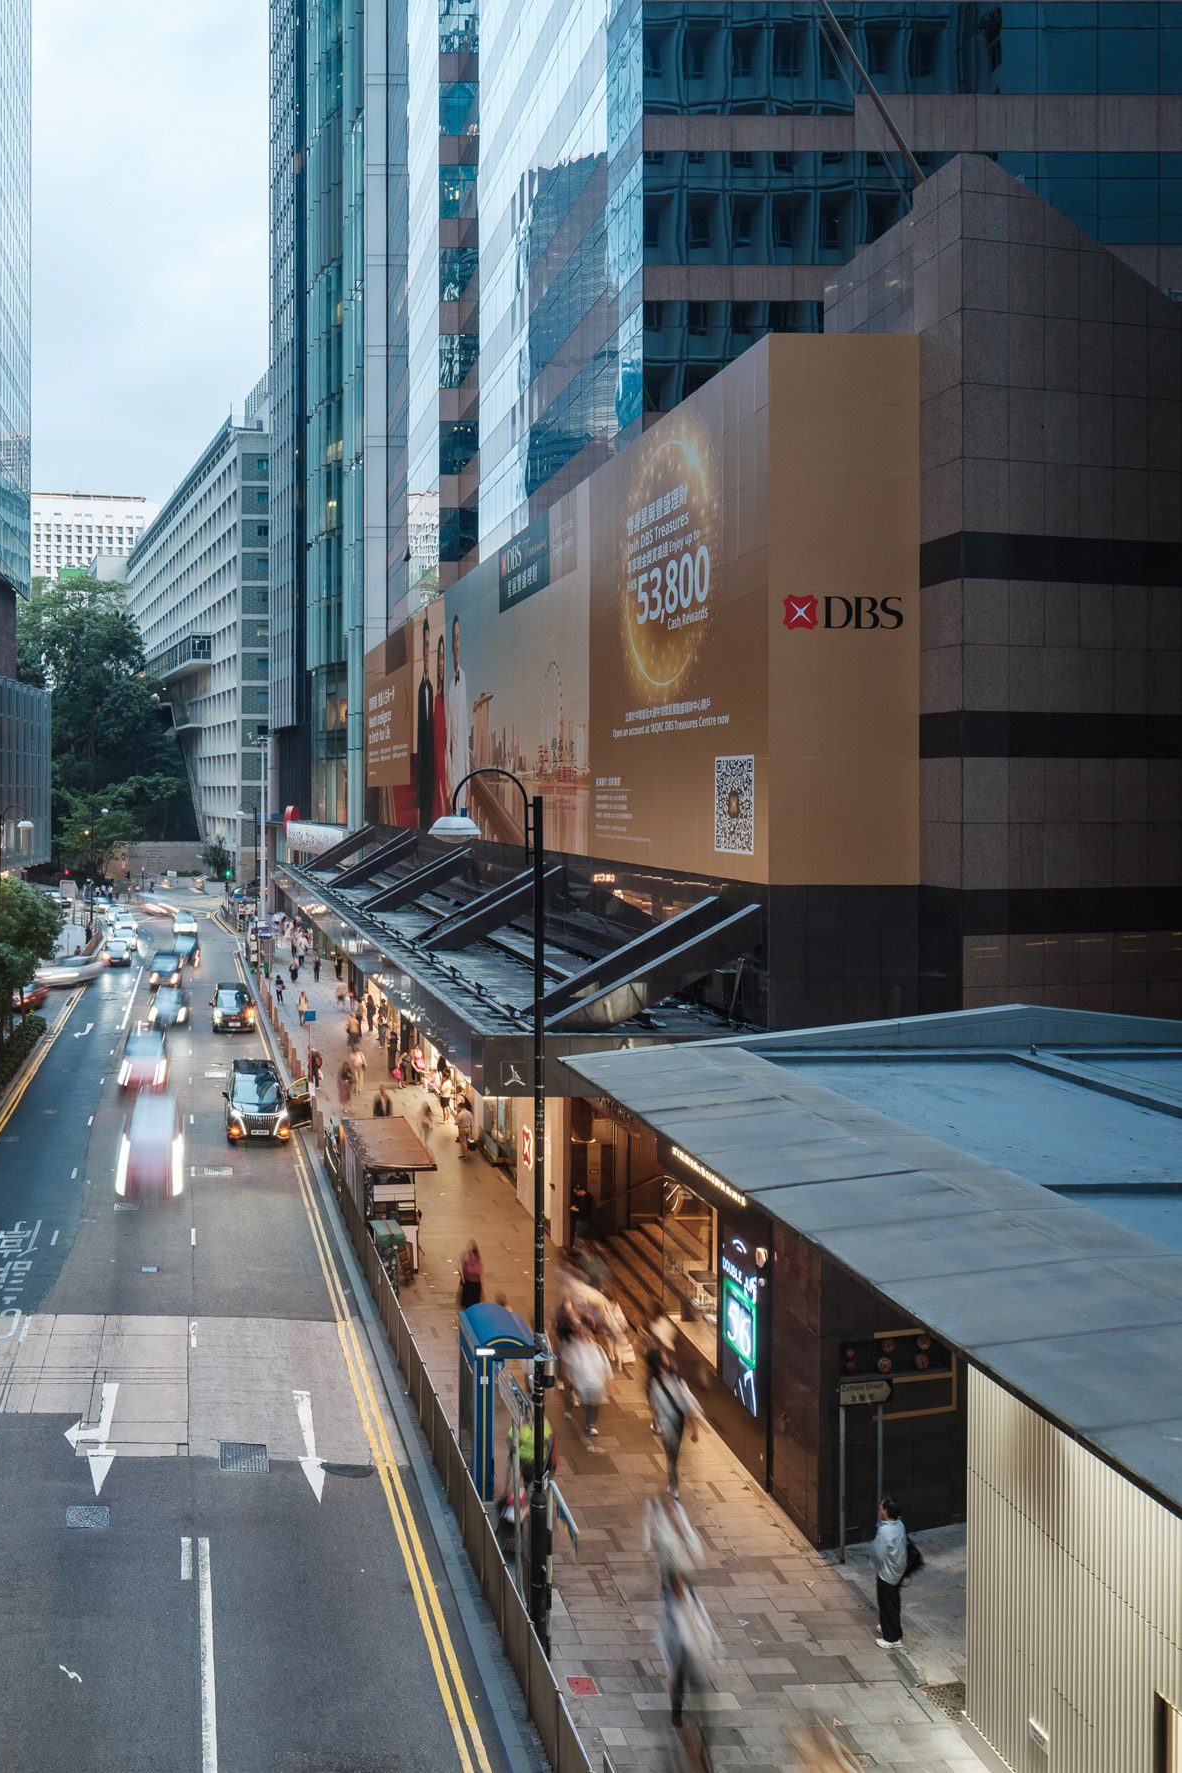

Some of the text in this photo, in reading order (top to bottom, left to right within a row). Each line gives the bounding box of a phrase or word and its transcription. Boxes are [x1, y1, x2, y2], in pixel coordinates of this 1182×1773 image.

[626, 511, 689, 560] Join DBS Treasures
[669, 537, 684, 554] Enjoy
[684, 532, 693, 546] up
[693, 528, 700, 541] to
[507, 540, 522, 573] DBS
[636, 544, 710, 625] 53,800
[667, 605, 709, 631] Cash Rewards
[823, 596, 905, 630] DBS
[674, 718, 698, 730] Treasures
[698, 715, 716, 728] Centre
[717, 714, 730, 725] now
